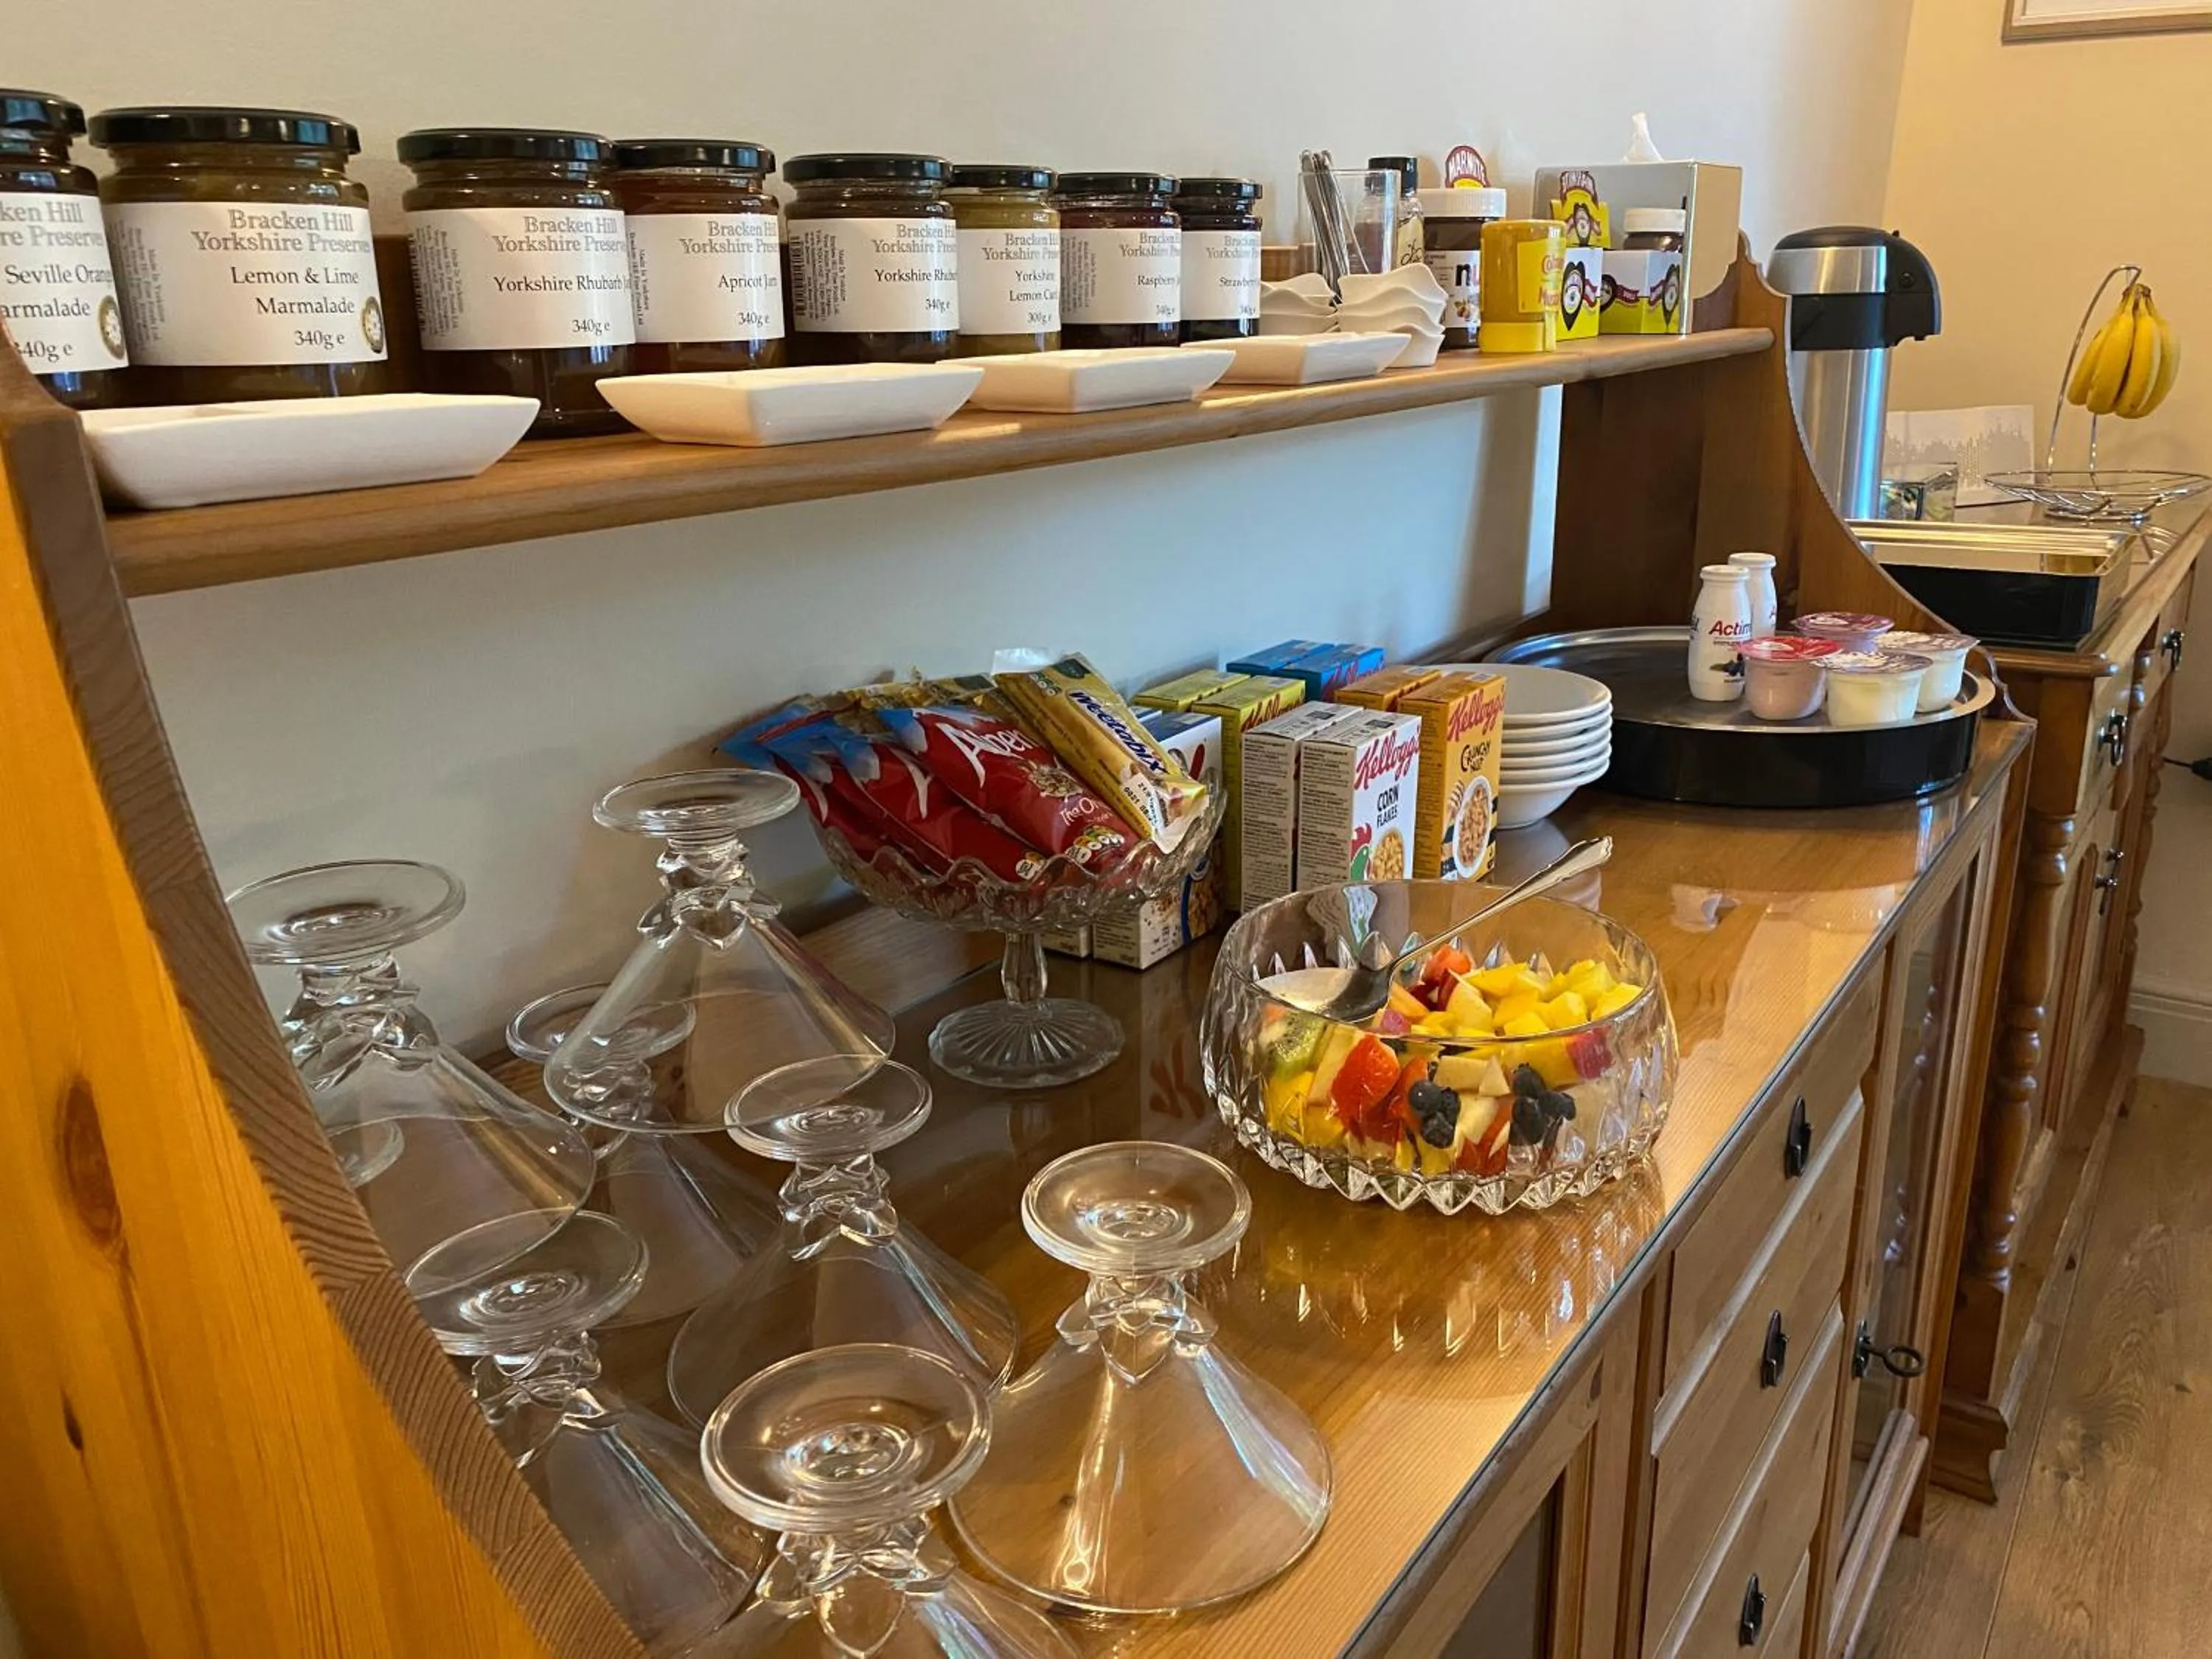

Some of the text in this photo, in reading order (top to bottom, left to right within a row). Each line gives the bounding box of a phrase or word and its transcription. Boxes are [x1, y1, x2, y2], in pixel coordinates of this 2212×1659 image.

[46, 201, 83, 223] Hill
[229, 209, 353, 232] Bracken Hill
[524, 215, 618, 234] Bracken Hill
[708, 220, 762, 237] Bracken
[896, 223, 943, 238] Bracken
[191, 231, 302, 251] Yorkshire
[492, 235, 581, 252] Yorkshire
[680, 237, 753, 254] Yorkshire
[872, 239, 936, 253] Yorkshire
[981, 247, 1040, 260] Yorkshire
[4, 264, 73, 285] Seville
[231, 266, 359, 284] Lemon & Lime
[493, 275, 573, 292] Yorkshire
[576, 274, 622, 290] Rhubarb
[718, 274, 762, 293] Apricot
[874, 269, 932, 282] Yorkshire
[1009, 290, 1041, 302] Lemon
[256, 297, 355, 315] Marmalade
[572, 319, 602, 336] 340g
[738, 312, 763, 328] 340g
[295, 330, 333, 350] 340g
[1447, 683, 1506, 742] Kellogg's
[1069, 689, 1170, 774] Weetabix
[1377, 783, 1399, 812] CORN
